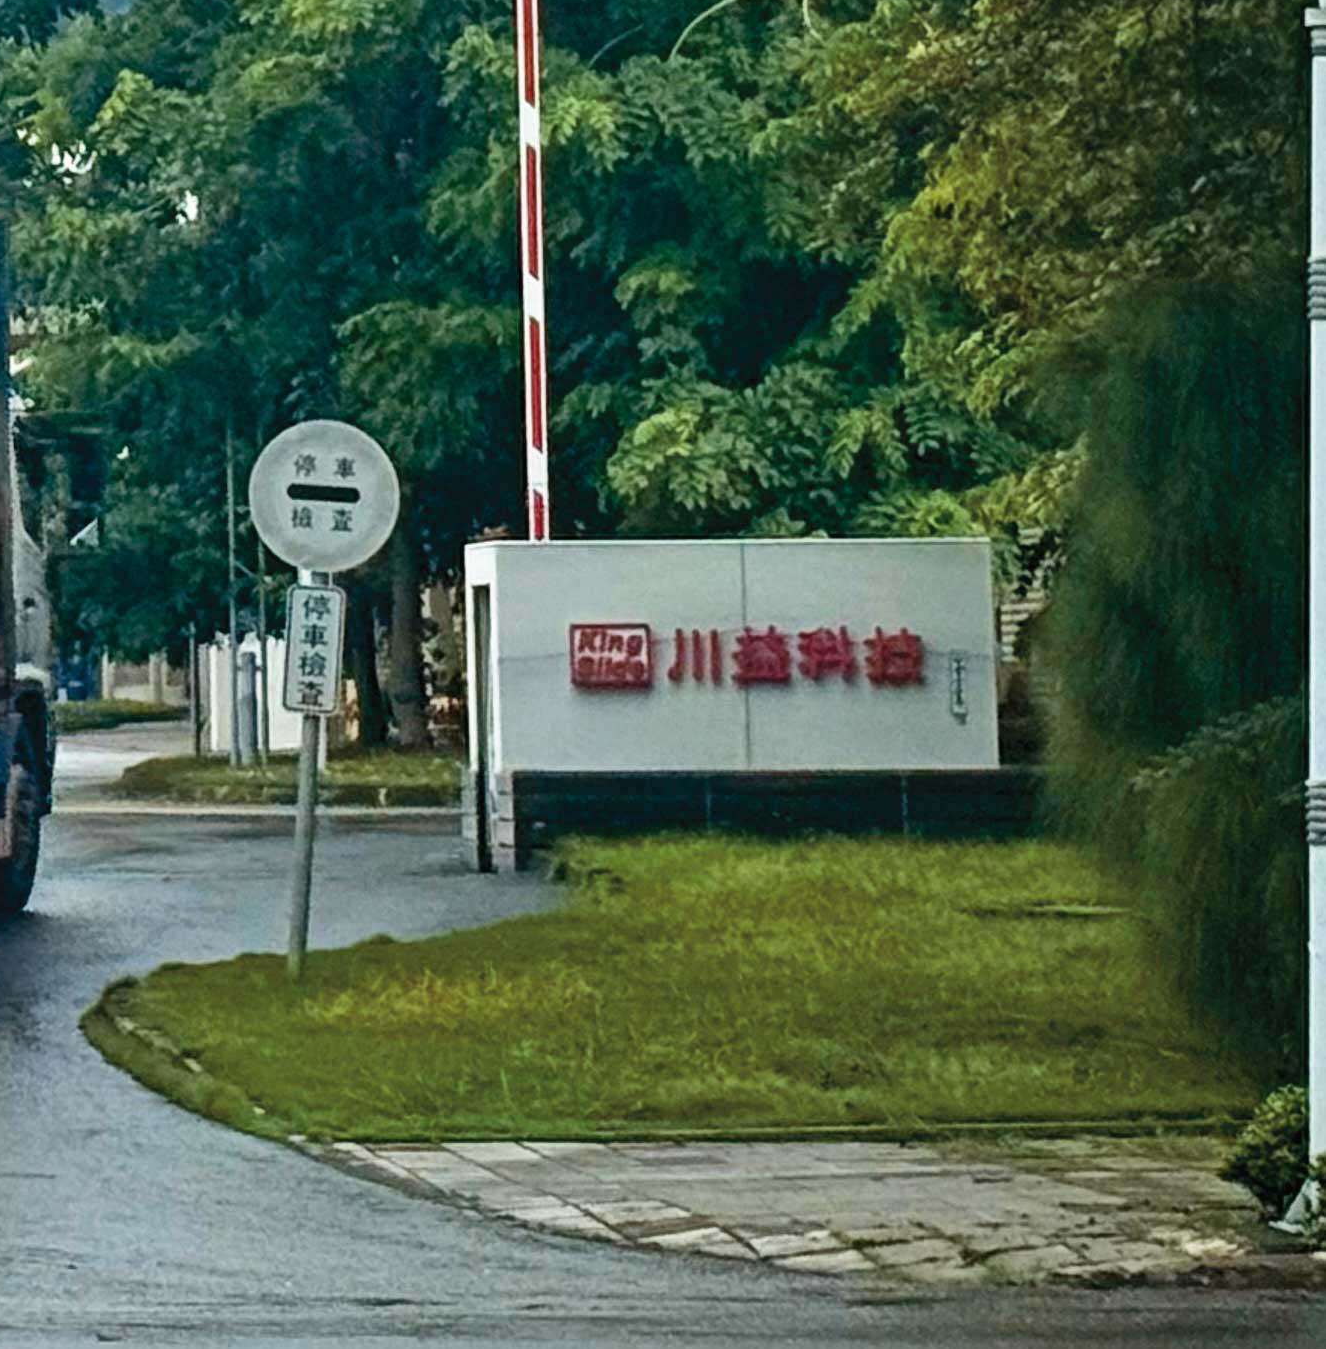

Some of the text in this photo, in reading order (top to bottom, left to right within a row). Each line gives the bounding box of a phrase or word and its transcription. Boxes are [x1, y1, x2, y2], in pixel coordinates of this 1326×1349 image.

[294, 454, 356, 479] 停車
[291, 506, 353, 532] 檢查
[298, 594, 331, 708] 停車檢查
[578, 630, 643, 657] King
